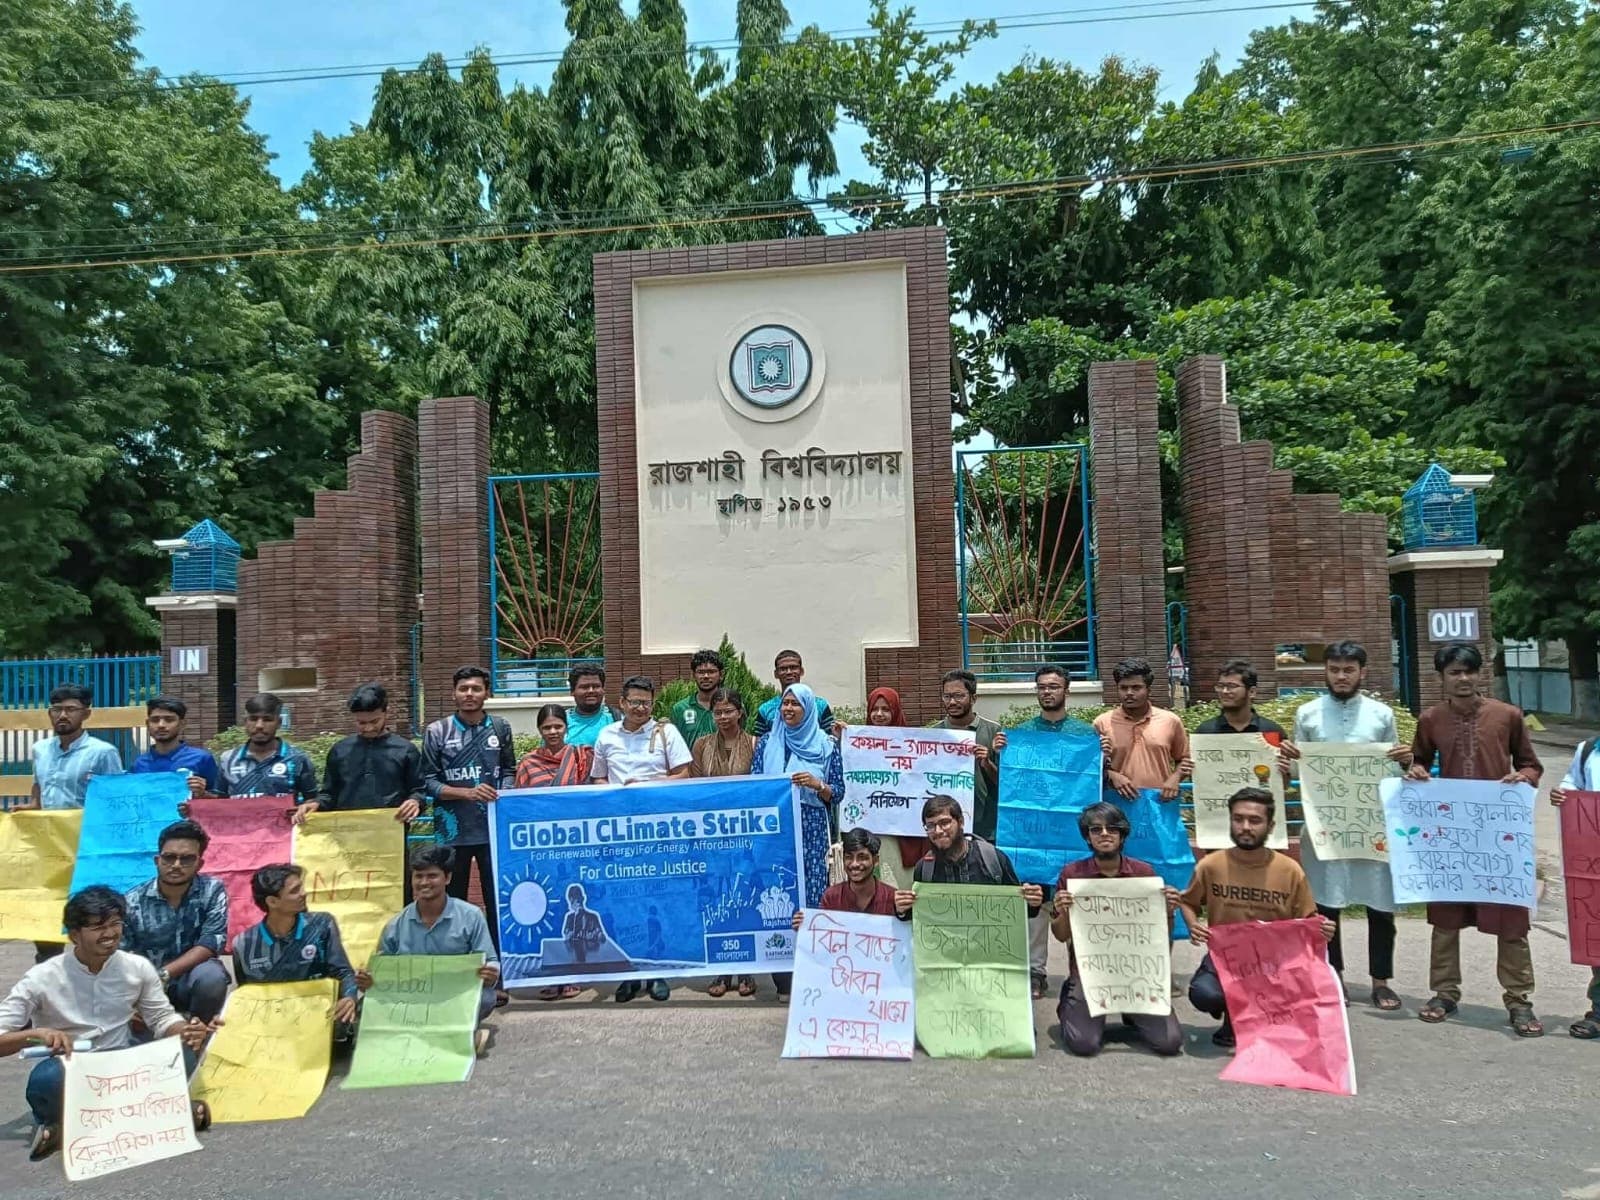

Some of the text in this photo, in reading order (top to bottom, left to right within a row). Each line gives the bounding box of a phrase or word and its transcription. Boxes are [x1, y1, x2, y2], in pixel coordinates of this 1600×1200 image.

[648, 447, 903, 485] রাজশাহী বিশ্ববিদ্যালয়
[716, 493, 832, 516] স্থাপিত ১৯৫৩
[1432, 612, 1475, 637] OUT
[179, 649, 200, 671] IN
[511, 821, 590, 848] Global
[702, 810, 779, 836] Strike
[530, 851, 546, 861] For
[549, 847, 600, 860] Renewable
[657, 842, 690, 854] Energy
[693, 836, 754, 850] Affordability
[580, 859, 707, 880] For Climate Justice
[1211, 883, 1290, 905] BURBERRY
[723, 939, 740, 951] 350
[808, 912, 851, 955] বিল
